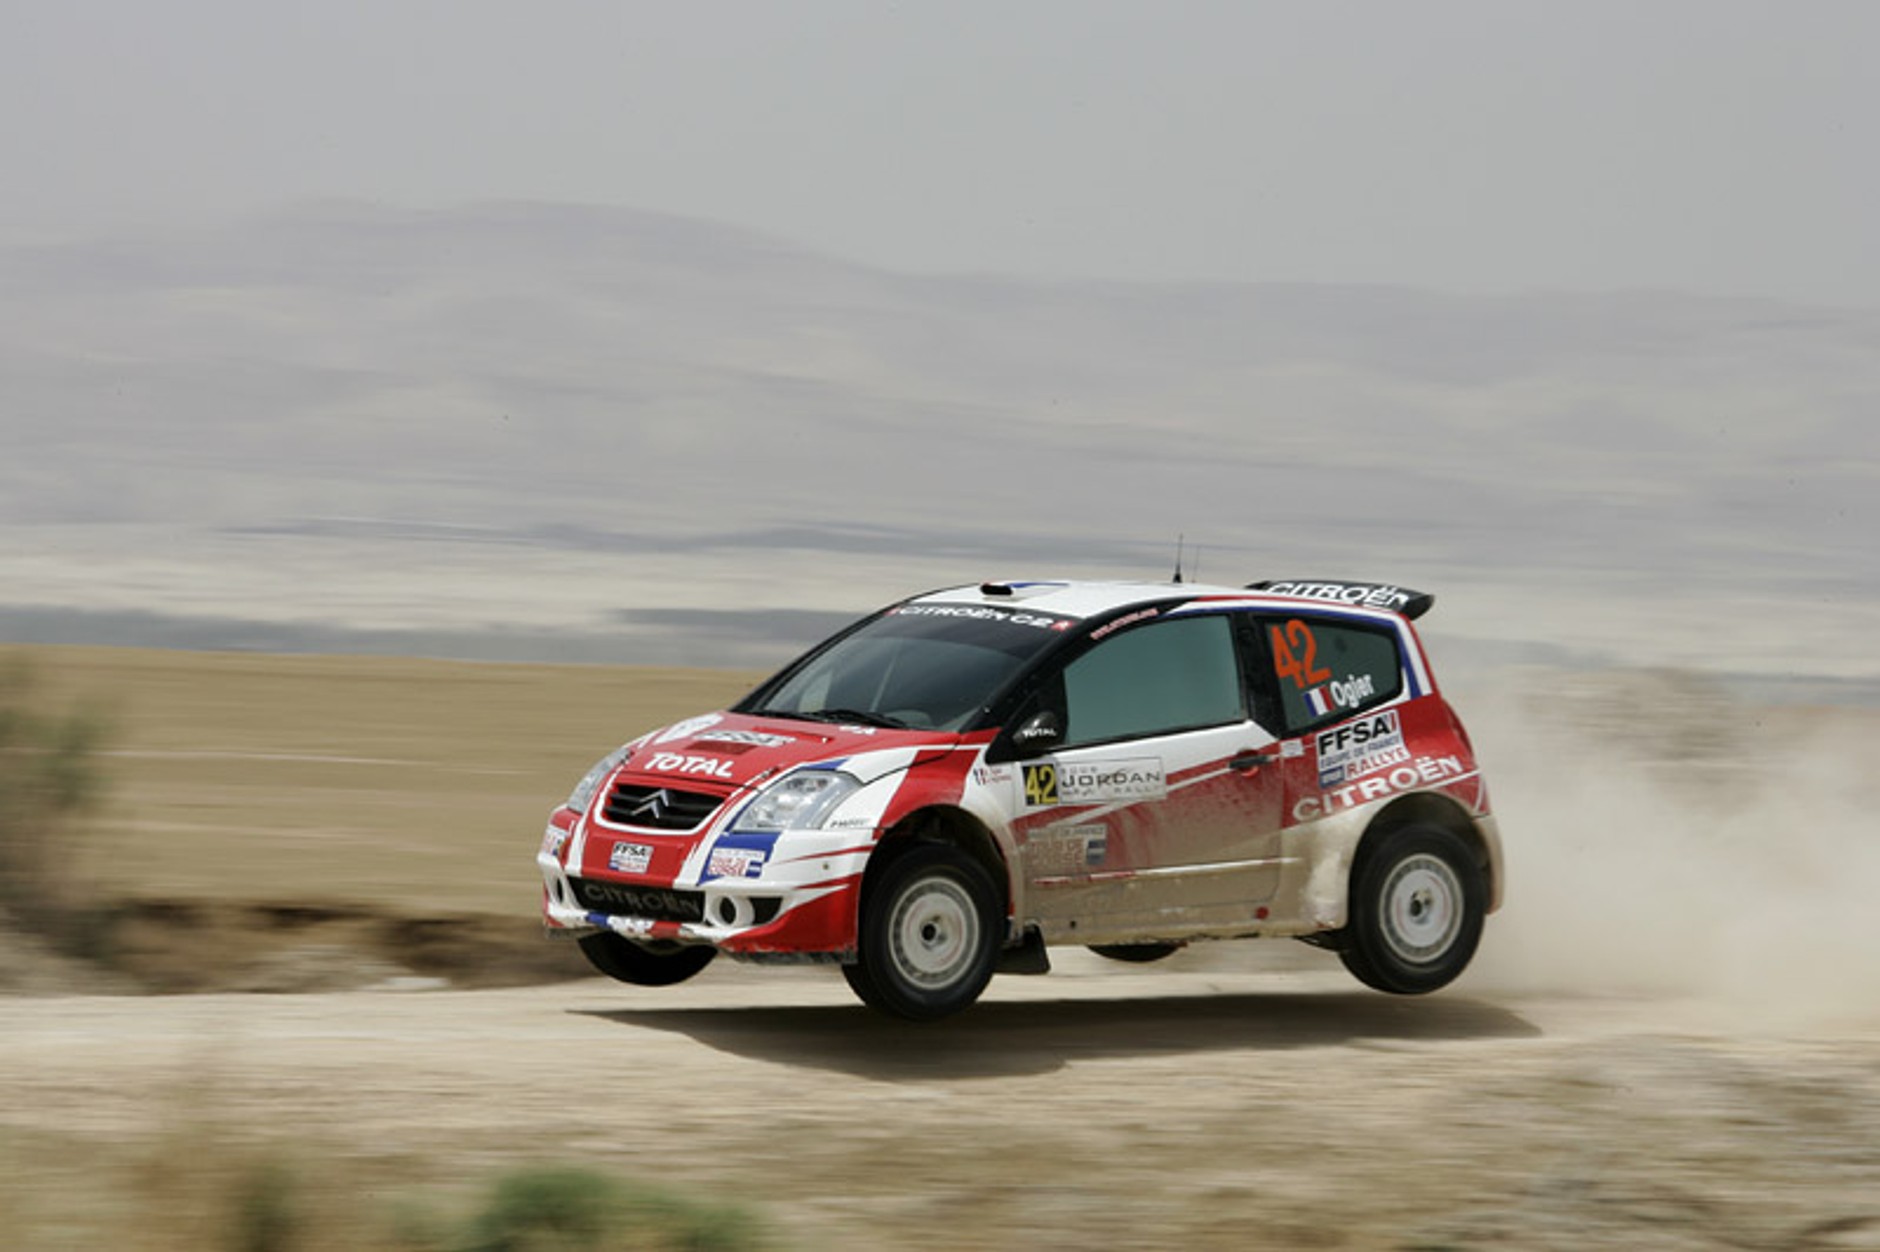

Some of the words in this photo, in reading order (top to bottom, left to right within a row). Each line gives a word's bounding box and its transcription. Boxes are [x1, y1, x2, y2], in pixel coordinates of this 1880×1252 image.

[1270, 618, 1332, 689] 42
[1330, 673, 1374, 708] Ogier
[1022, 728, 1058, 738] TOTAL
[1318, 716, 1391, 756] FFSA
[644, 751, 735, 777] TOTAL
[1347, 746, 1404, 776] RALLYE
[1026, 765, 1057, 805] 42
[1061, 771, 1161, 788] JORDAN
[1292, 755, 1463, 822] CITROËN
[613, 843, 647, 857] FFSA
